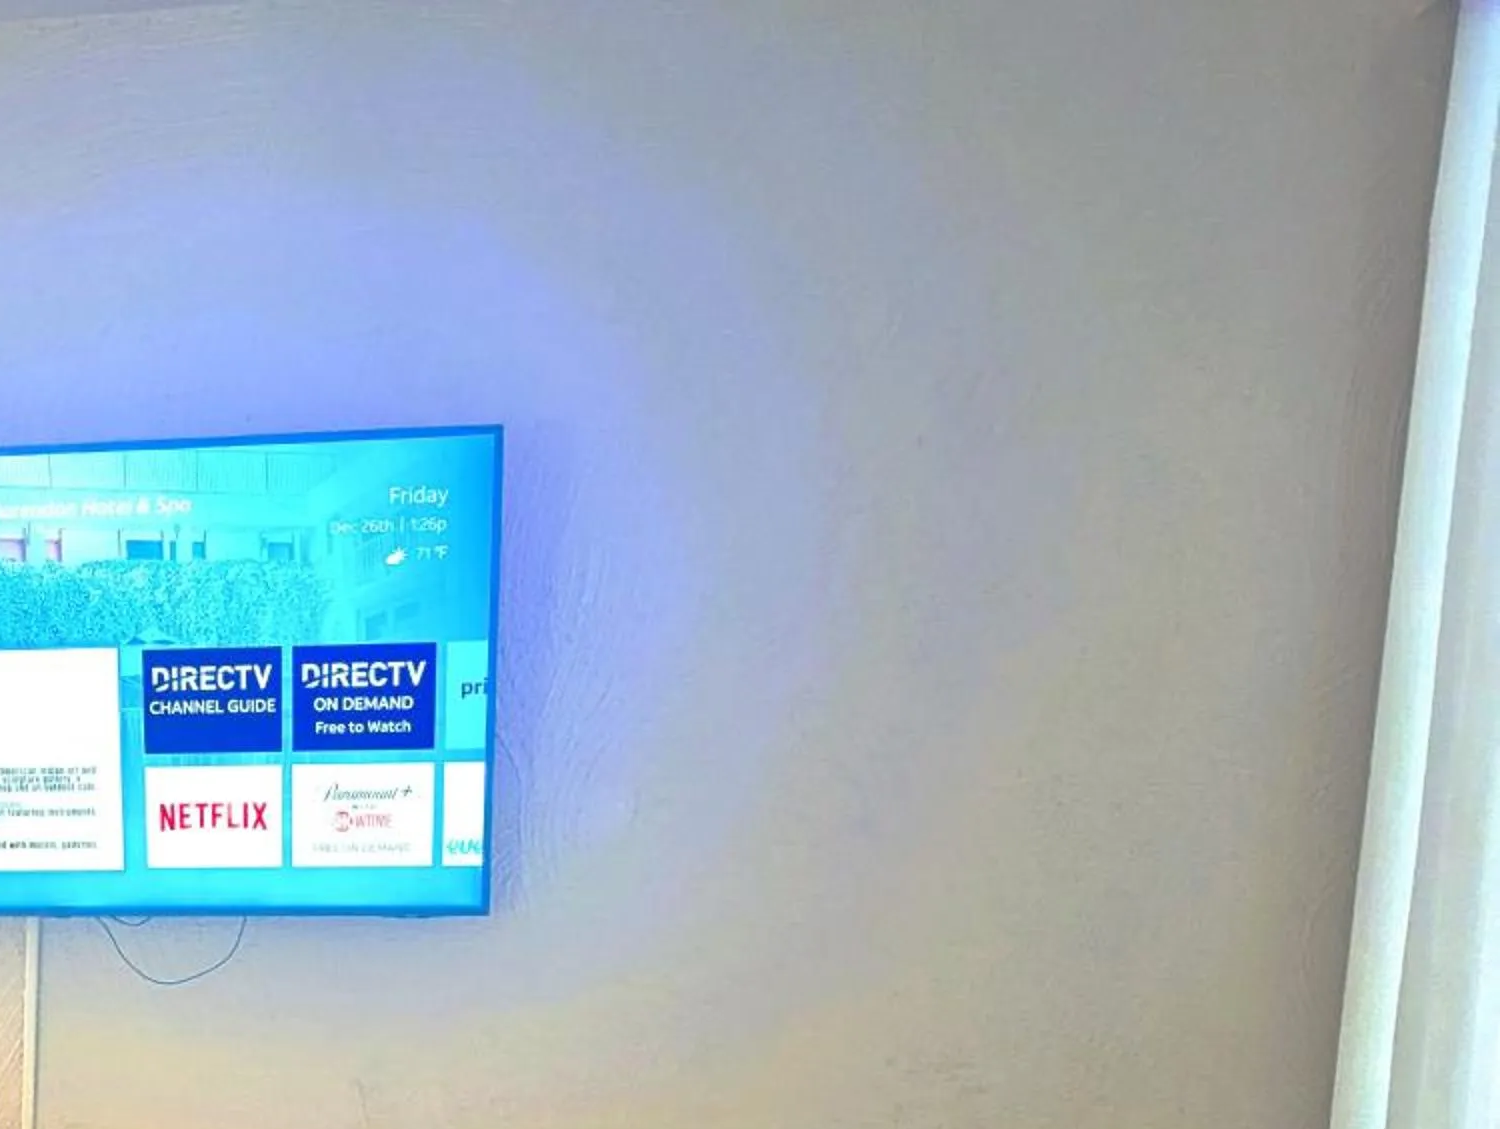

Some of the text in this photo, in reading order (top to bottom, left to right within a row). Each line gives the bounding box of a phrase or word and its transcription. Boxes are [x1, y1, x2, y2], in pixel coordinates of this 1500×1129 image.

[389, 485, 448, 507] Friday
[361, 518, 395, 534] 26th
[151, 664, 273, 693] DIRECTV
[301, 660, 427, 689] DIRECTV
[149, 698, 277, 715] CHANNEL GUIDE
[313, 695, 414, 712] ON DEMAND
[315, 719, 412, 735] Free to Watch
[159, 801, 268, 832] NETFLIX
